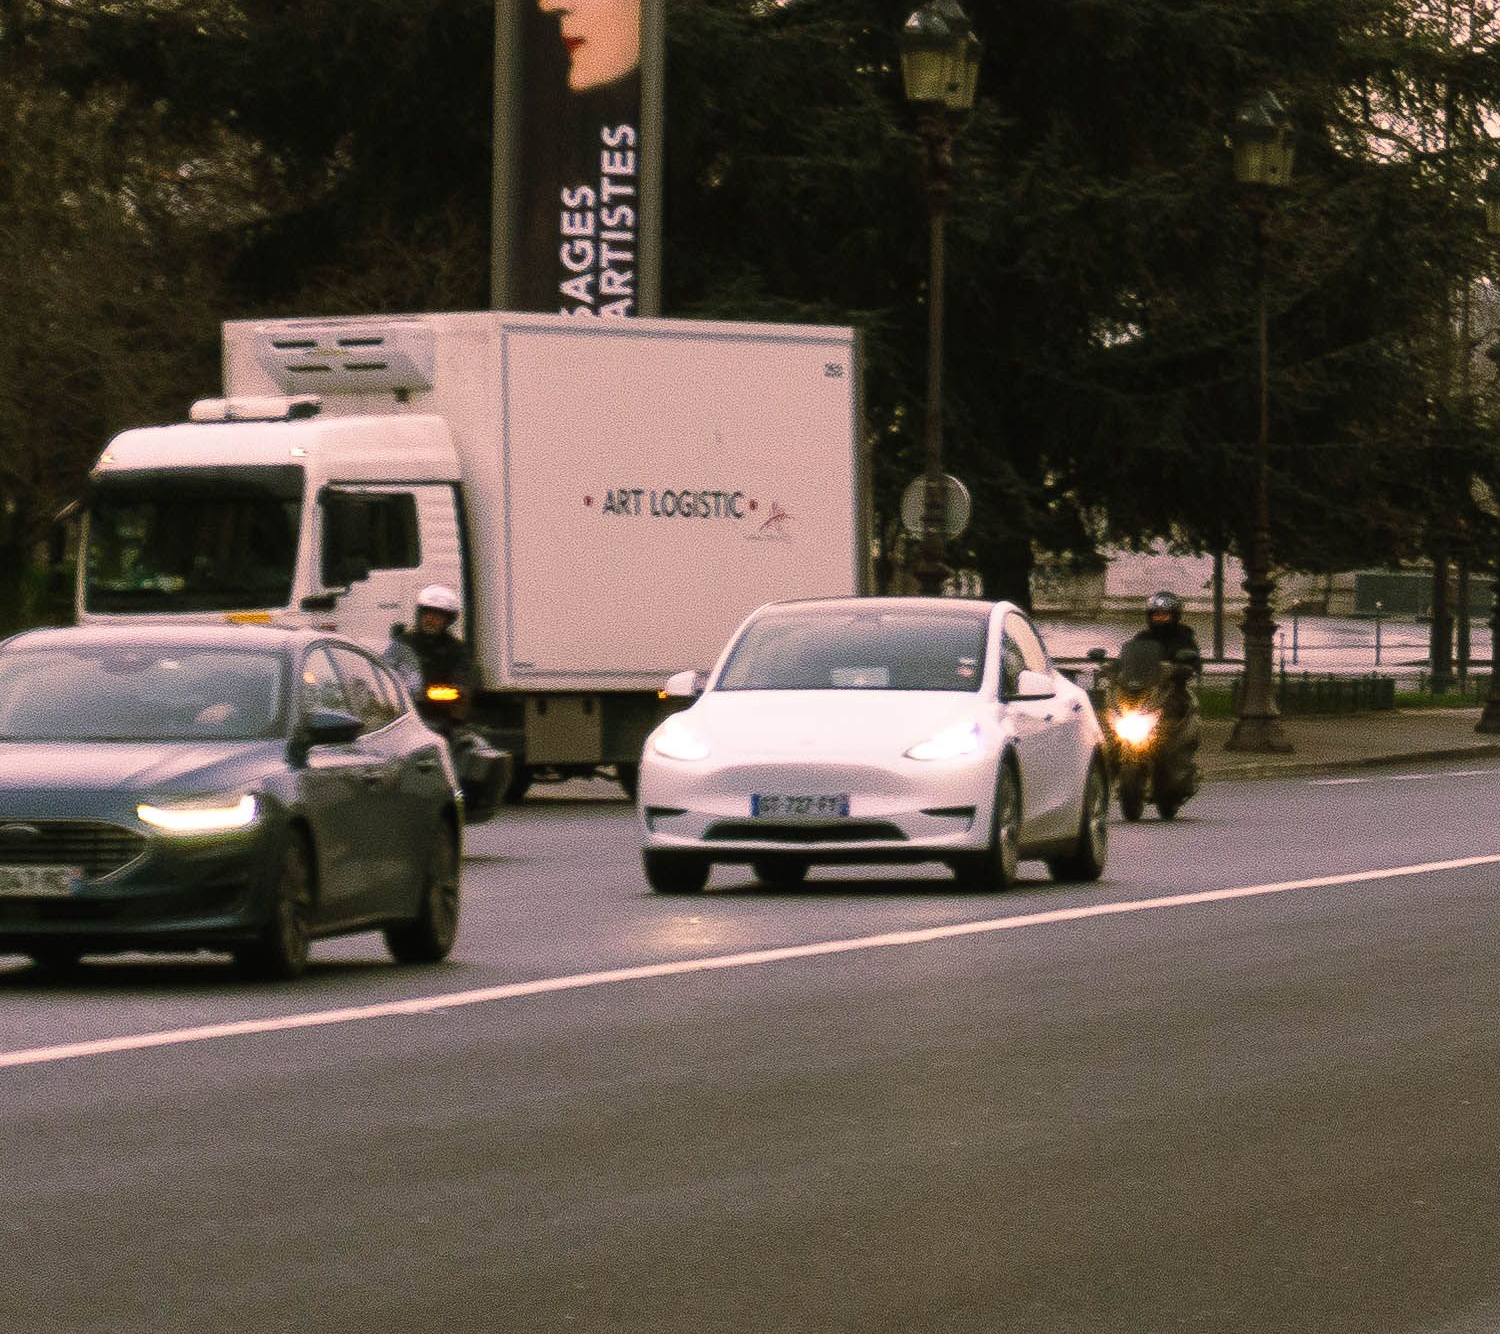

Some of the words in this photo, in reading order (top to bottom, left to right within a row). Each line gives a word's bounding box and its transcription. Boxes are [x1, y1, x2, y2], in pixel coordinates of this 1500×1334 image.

[599, 123, 637, 318] ARTISTES
[602, 488, 644, 516] ART
[649, 489, 745, 519] LOGISTIC
